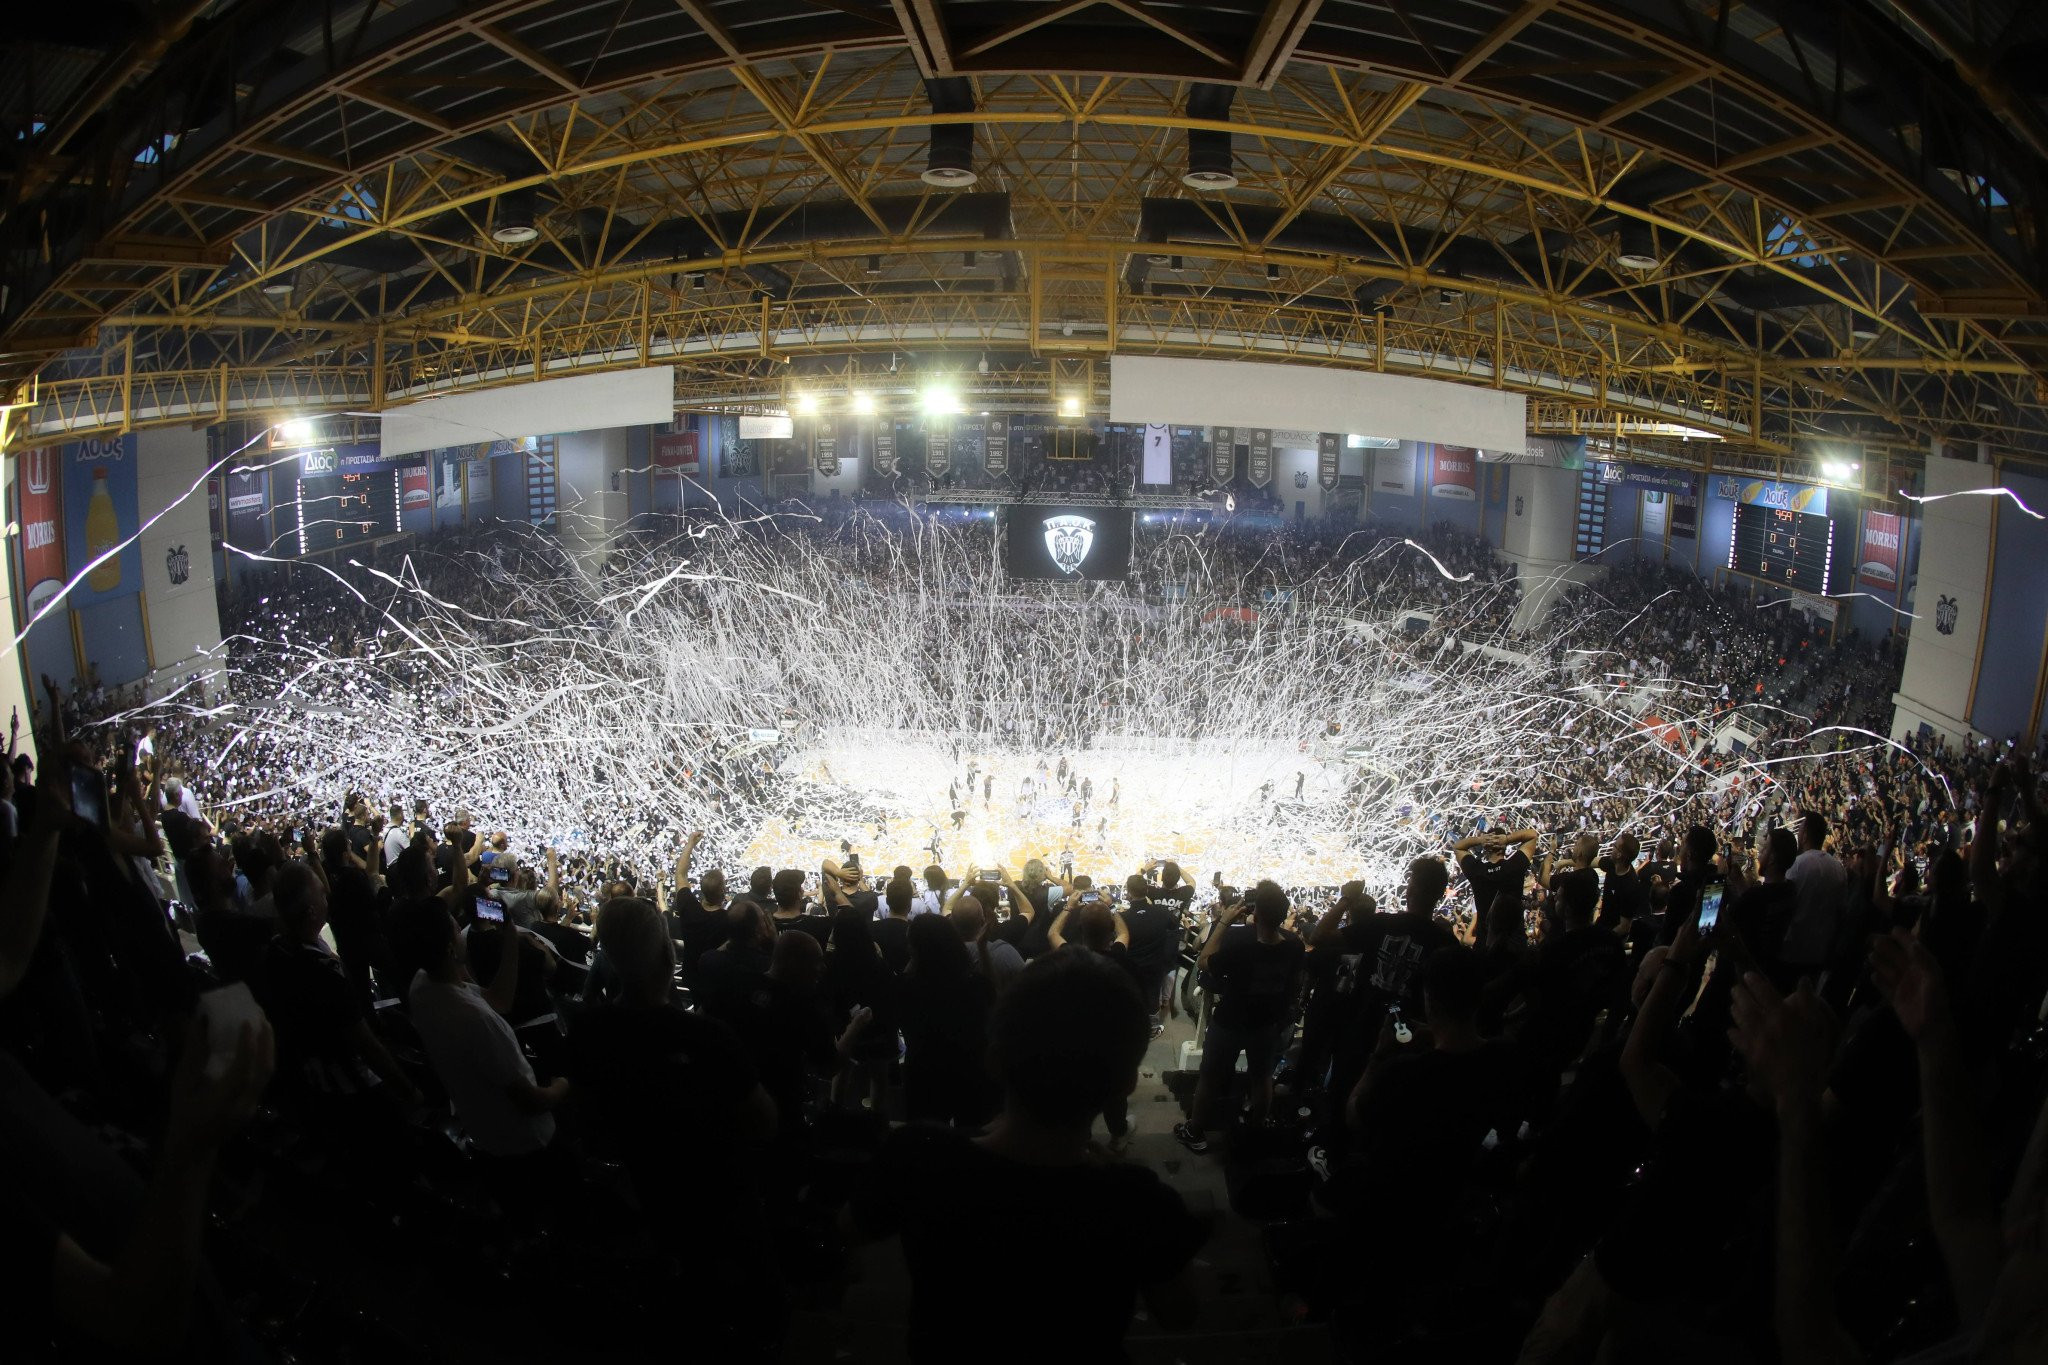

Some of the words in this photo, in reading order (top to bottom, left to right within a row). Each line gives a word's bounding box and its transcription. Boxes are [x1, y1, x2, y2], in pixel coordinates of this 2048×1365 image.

[1155, 436, 1162, 447] 7
[1439, 460, 1471, 472] MORRIS
[27, 520, 56, 550] MORRIS
[1865, 529, 1899, 550] MORRIS
[1154, 898, 1183, 908] PAOK
